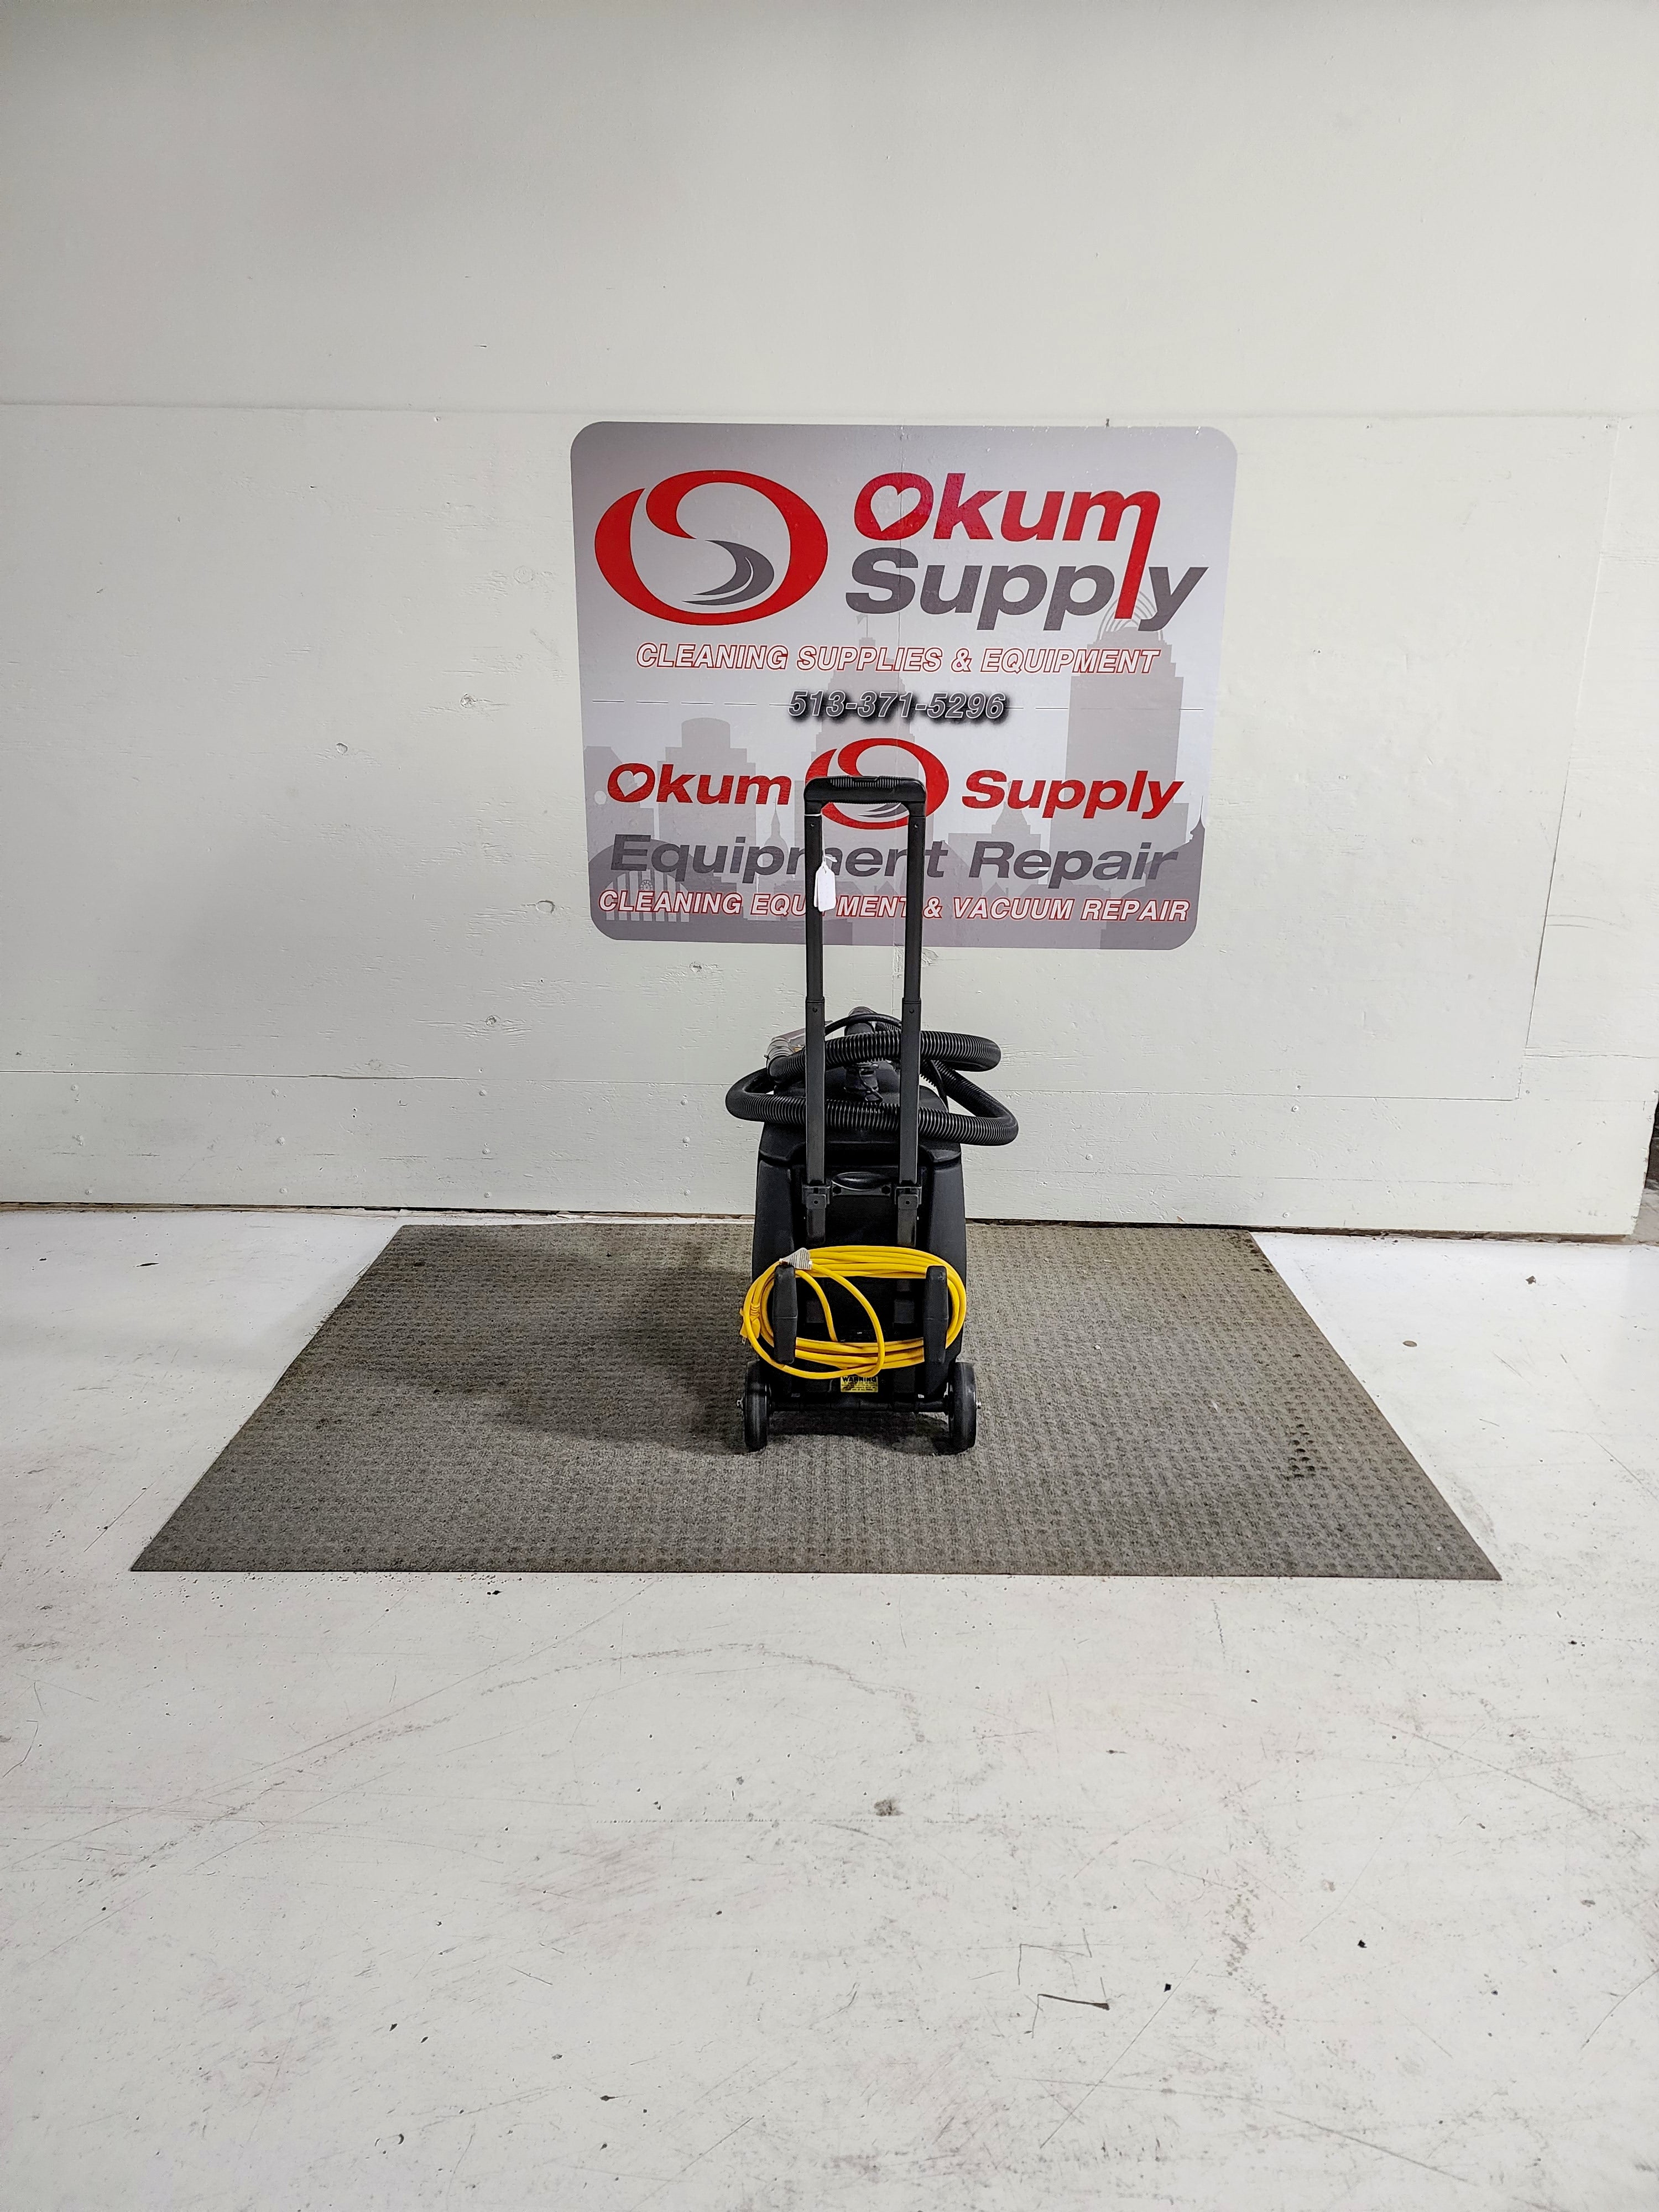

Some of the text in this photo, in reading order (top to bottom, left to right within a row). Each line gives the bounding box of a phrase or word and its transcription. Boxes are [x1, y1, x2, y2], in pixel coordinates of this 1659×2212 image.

[854, 472, 1161, 619] Okum
[845, 547, 1209, 631] Supply
[637, 642, 1161, 674] CLEANING SUPPLIES & EQUIPMENT
[788, 690, 1006, 719] 513-371-5296
[607, 763, 1185, 819] Okum Supply
[968, 841, 1178, 889] Repair
[599, 890, 742, 915] CLEANING
[922, 897, 943, 919] &
[953, 897, 1076, 921] VACUUM
[1080, 899, 1191, 922] REPAIR
